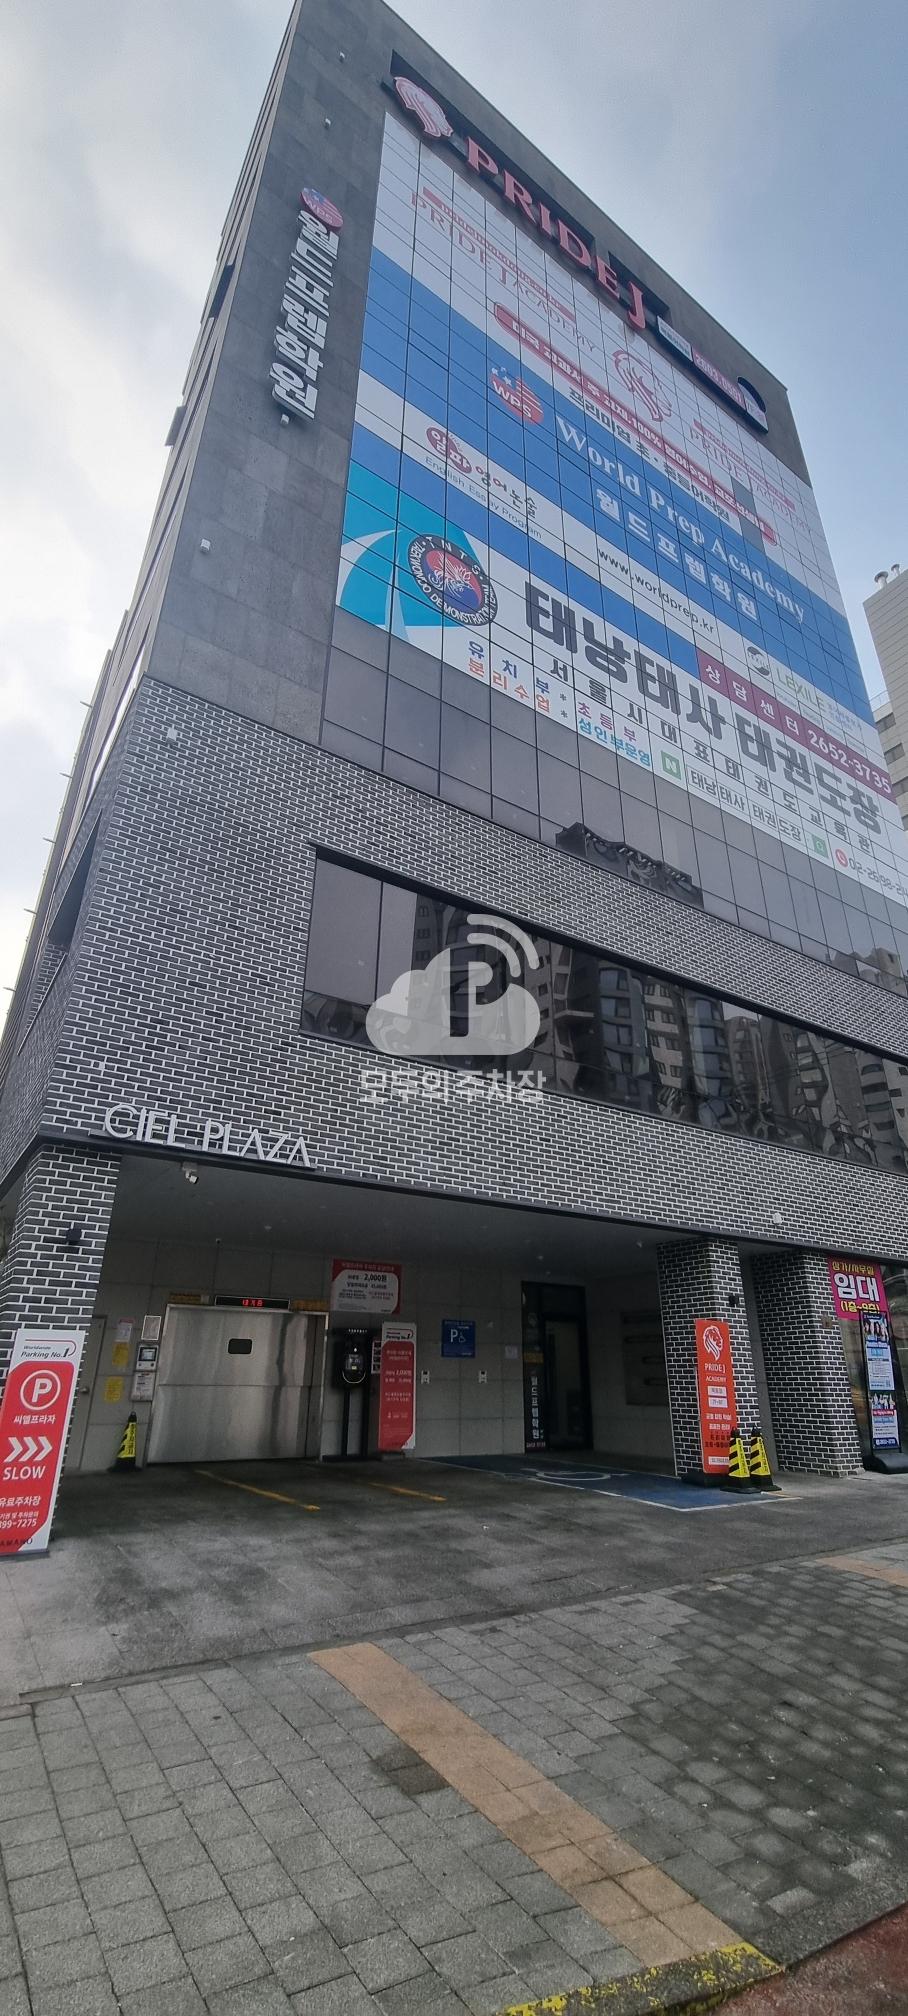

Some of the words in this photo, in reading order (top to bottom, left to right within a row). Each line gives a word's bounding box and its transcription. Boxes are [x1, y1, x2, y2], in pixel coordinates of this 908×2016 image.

[411, 191, 492, 270] PRIDE
[513, 279, 597, 352] ACADEMY
[269, 209, 341, 419] 월드프렙학원
[492, 380, 533, 419] WPS
[425, 456, 465, 488] English
[502, 508, 542, 539] Program
[555, 415, 641, 497] World
[649, 485, 705, 548] Prep
[711, 537, 804, 624] Academy
[596, 488, 758, 621] 월드프렙학원
[599, 551, 715, 634] www.worldprep.kr
[524, 580, 727, 741] 태낭태사
[735, 711, 882, 835] 태권도장
[807, 729, 892, 794] 2652-3735
[690, 771, 746, 812] 태낭태사
[752, 804, 802, 842] 태권도장
[104, 1103, 186, 1148] CIEL
[202, 1118, 312, 1168] PLAZA
[833, 1272, 880, 1302] 임대
[21, 1351, 49, 1360] Parking
[50, 1347, 70, 1358] No.1
[704, 1362, 723, 1372] PRIDE
[705, 1375, 727, 1383] ACADEMY
[13, 1414, 57, 1425] 씨엘프라자
[3, 1465, 46, 1480] SLOW
